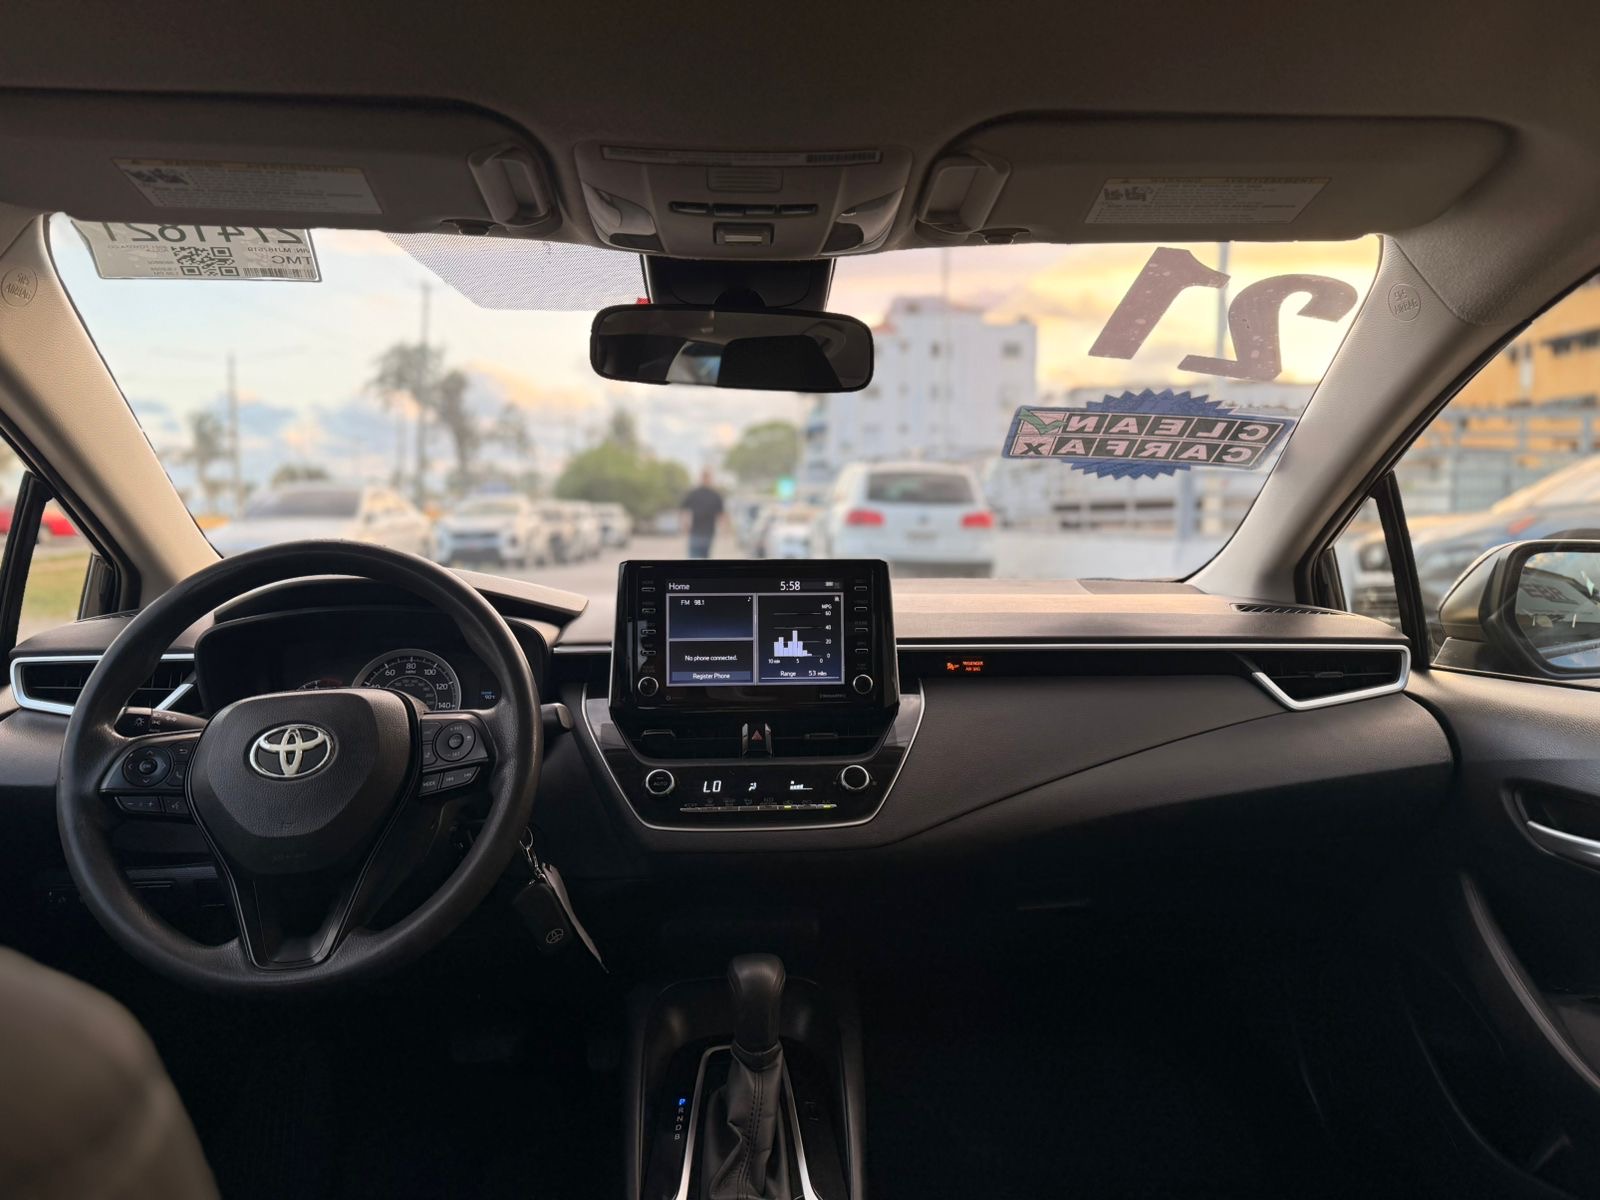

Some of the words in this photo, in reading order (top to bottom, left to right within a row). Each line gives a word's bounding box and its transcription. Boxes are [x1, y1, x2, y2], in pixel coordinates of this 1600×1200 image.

[668, 582, 690, 591] Home
[780, 580, 801, 592] 5:58
[693, 655, 710, 663] phone
[703, 780, 722, 793] LO
